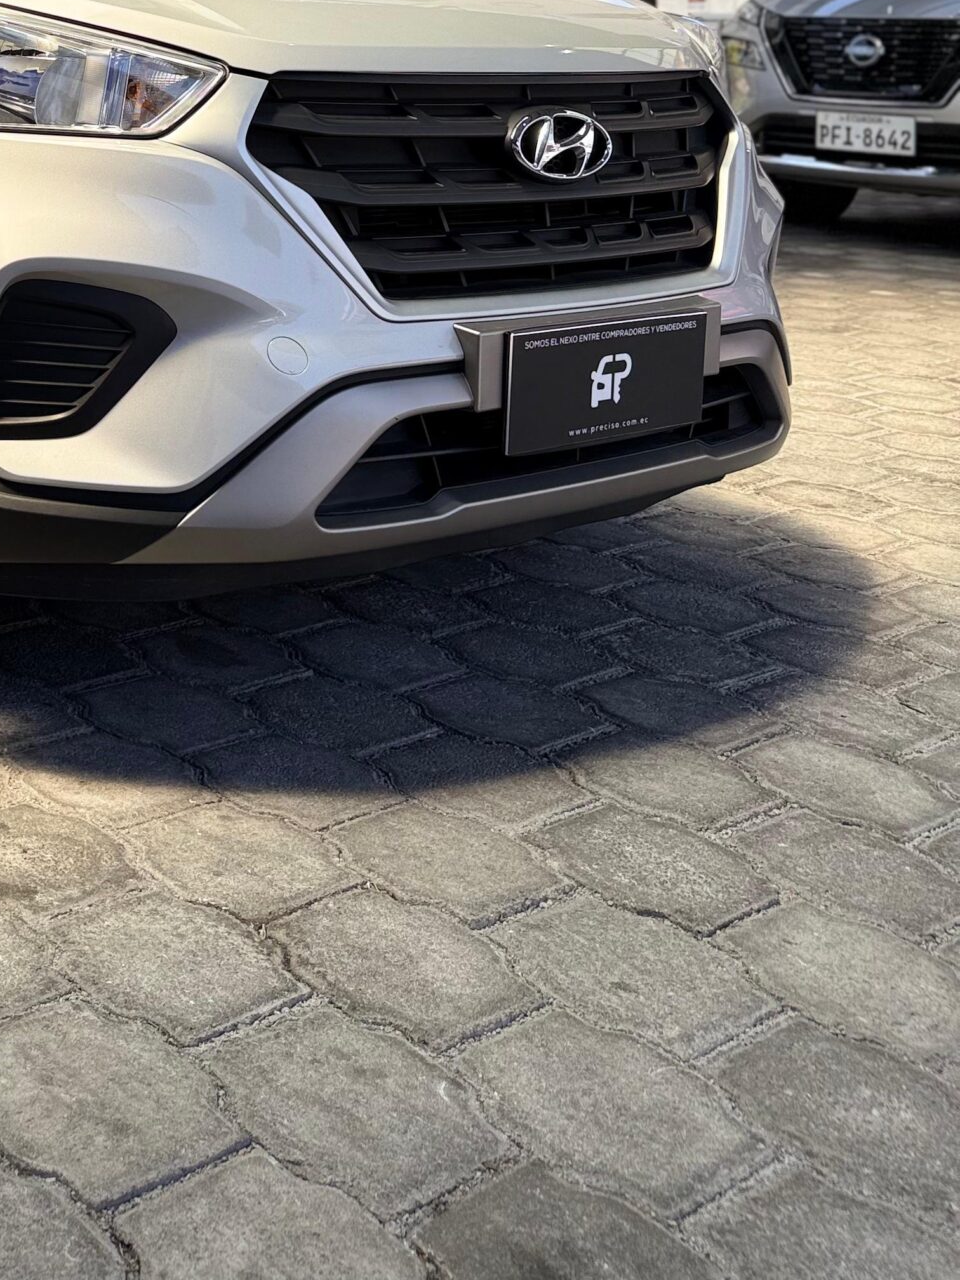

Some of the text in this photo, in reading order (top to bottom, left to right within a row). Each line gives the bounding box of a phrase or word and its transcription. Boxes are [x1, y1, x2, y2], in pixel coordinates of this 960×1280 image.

[524, 320, 697, 350] SOMOS EL NEXO ENTRE COMPRADORES Y VENDEDORES
[568, 416, 649, 437] www.preciso.com.ec
